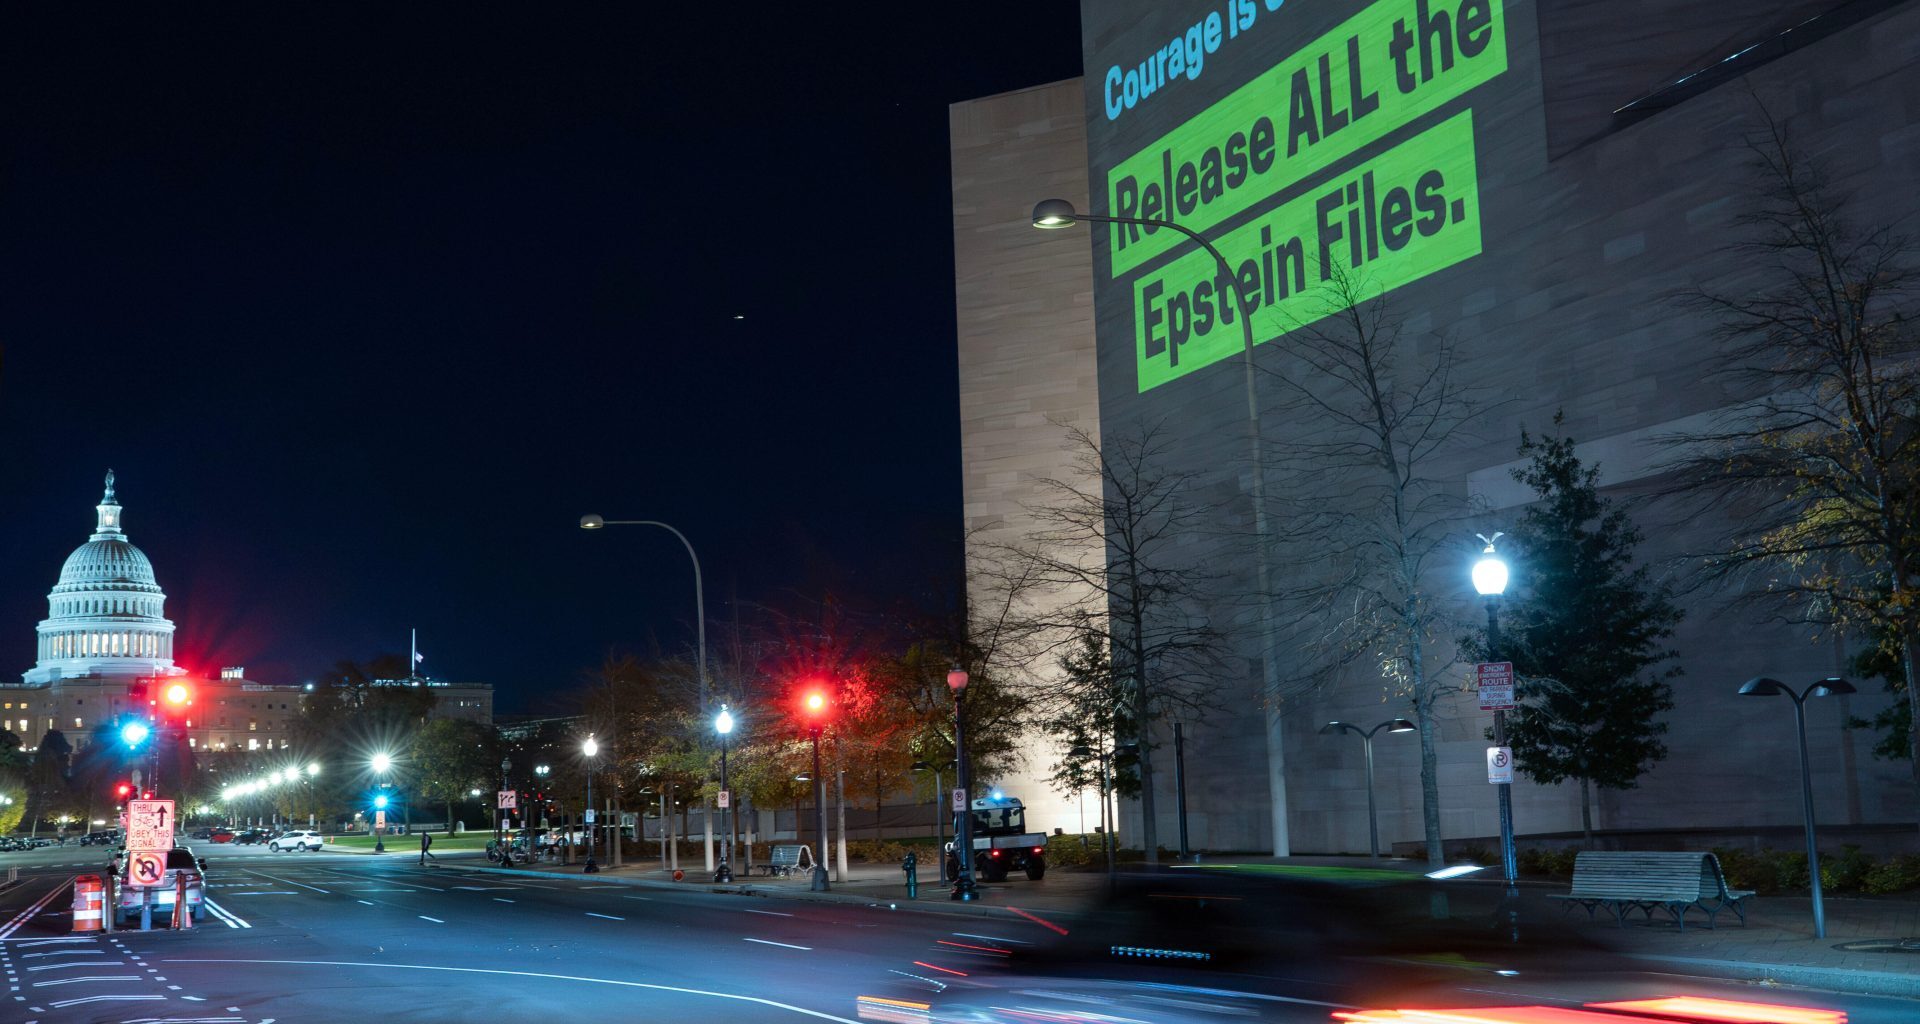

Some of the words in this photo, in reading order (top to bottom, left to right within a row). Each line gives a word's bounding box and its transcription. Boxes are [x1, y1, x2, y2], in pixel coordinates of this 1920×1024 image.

[1105, 11, 1222, 120] Courage
[1115, 116, 1276, 251] Release
[1287, 35, 1380, 159] ALL
[1389, 0, 1493, 95] the
[1142, 225, 1306, 368] Epstein
[1316, 169, 1466, 283] Files.
[1482, 678, 1508, 686] ROUTE
[133, 803, 153, 812] THRU
[154, 829, 170, 838] THIS
[131, 840, 156, 848] SIGNAL
